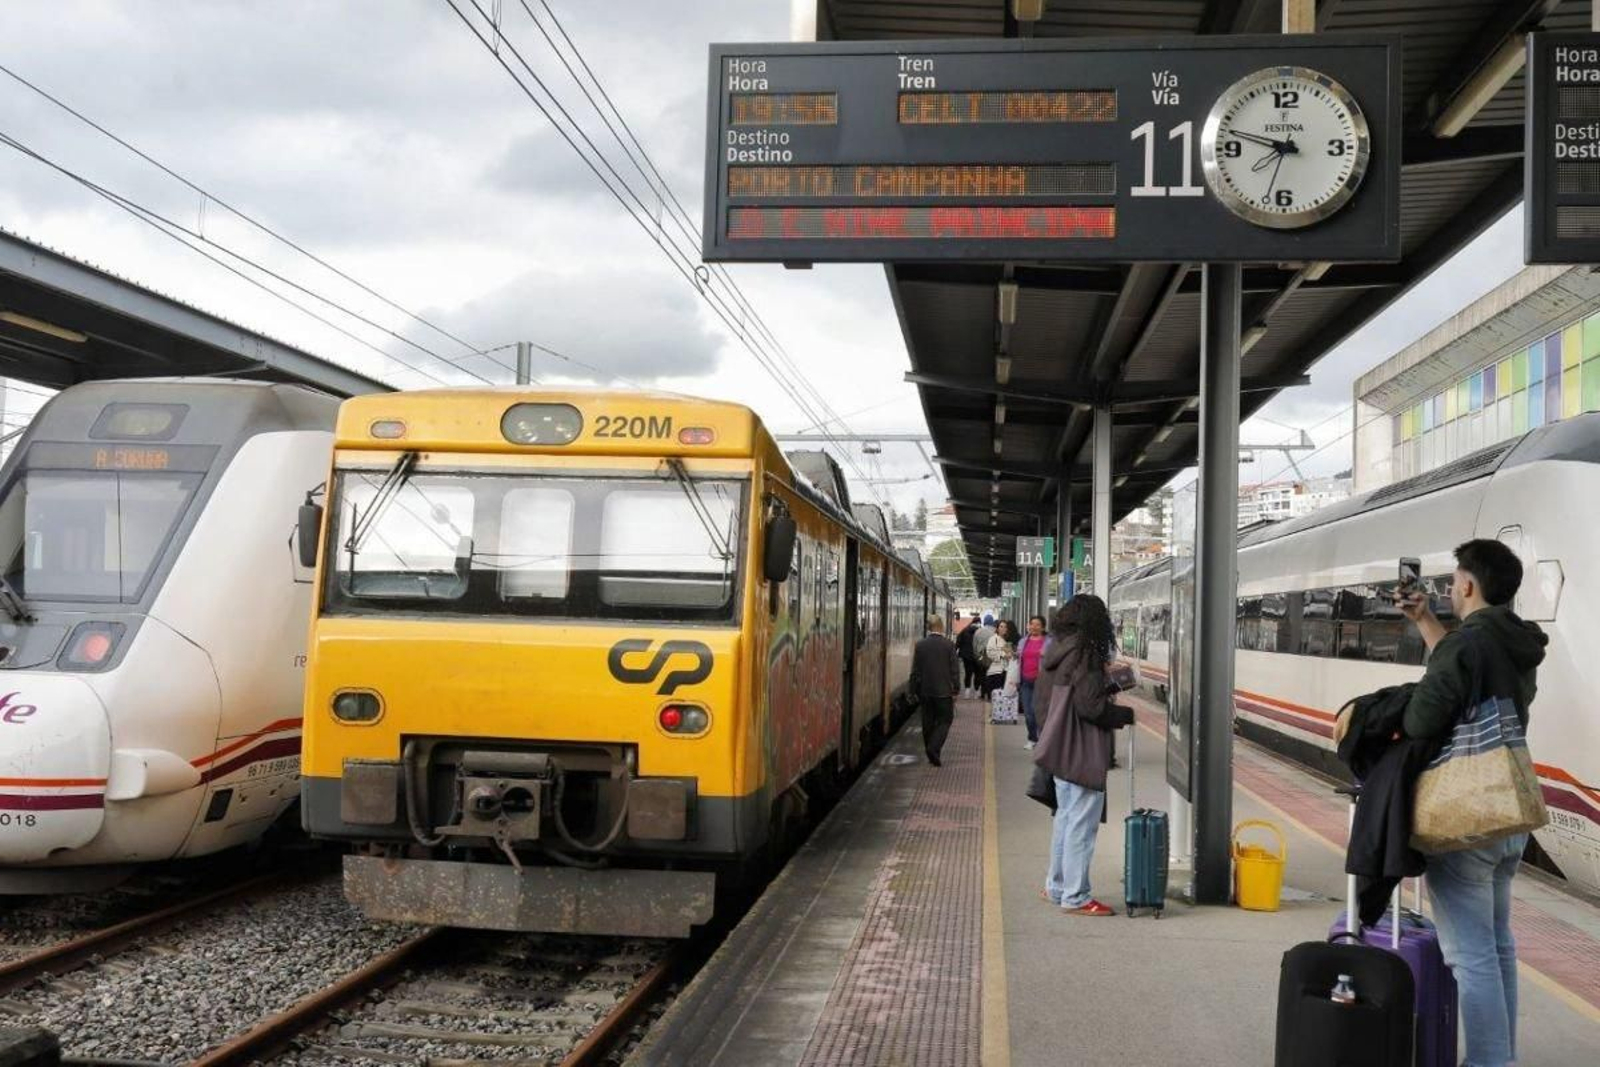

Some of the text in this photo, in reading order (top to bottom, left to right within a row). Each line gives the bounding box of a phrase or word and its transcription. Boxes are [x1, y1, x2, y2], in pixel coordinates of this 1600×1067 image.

[1556, 47, 1598, 62] Hora
[728, 59, 766, 73] Hora
[898, 56, 934, 71] Tren
[728, 76, 768, 91] Hora
[898, 74, 935, 88] Tren
[1152, 70, 1178, 87] Vía
[1152, 87, 1179, 105] Vía
[1271, 91, 1299, 108] 12
[1265, 124, 1304, 132] FESTINA
[727, 129, 790, 145] Destino
[727, 146, 793, 162] Destino
[1224, 141, 1241, 157] 9
[1328, 139, 1345, 156] 3
[1131, 121, 1204, 196] 11
[728, 167, 833, 196] PORTO
[1275, 190, 1293, 207] 6
[593, 415, 672, 439] 220M
[608, 639, 714, 695] CP
